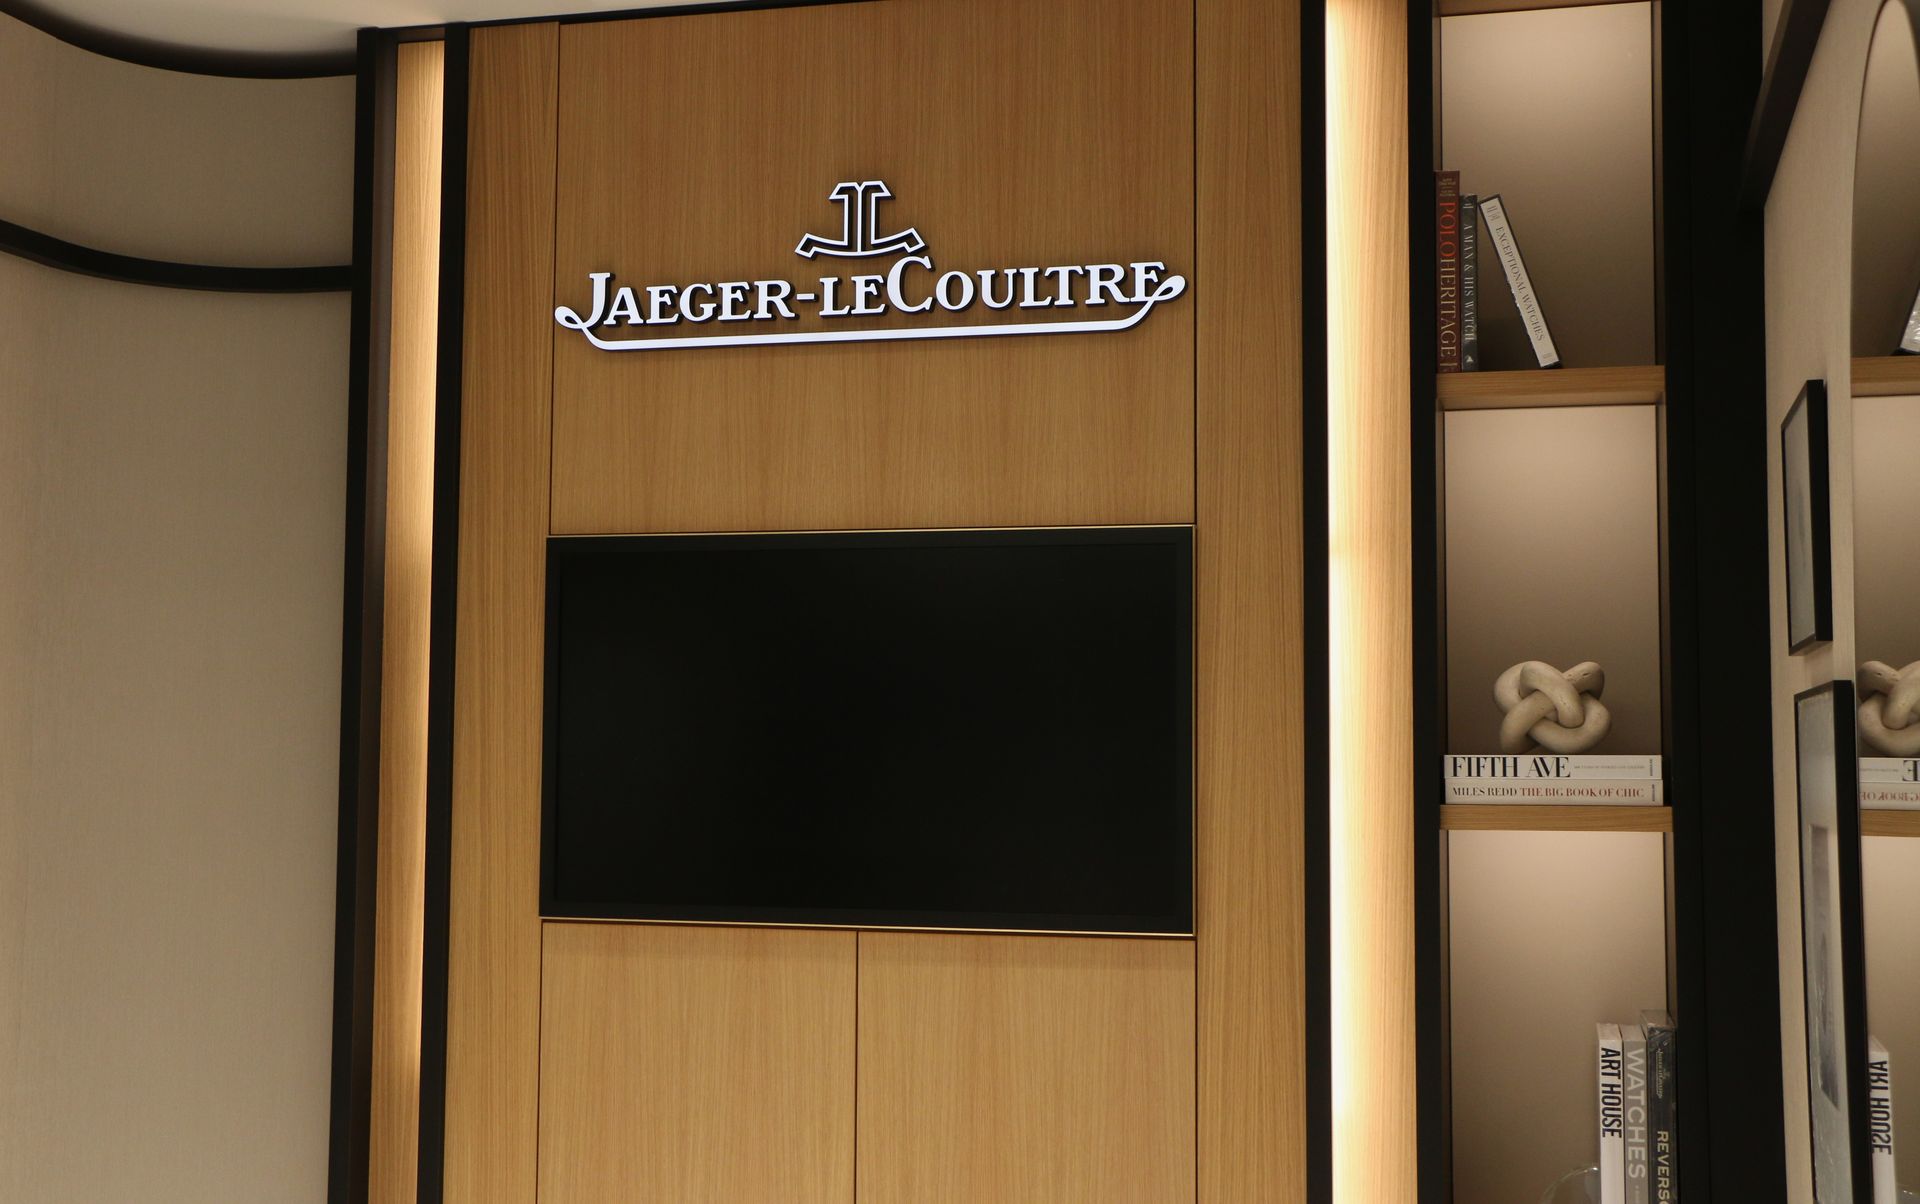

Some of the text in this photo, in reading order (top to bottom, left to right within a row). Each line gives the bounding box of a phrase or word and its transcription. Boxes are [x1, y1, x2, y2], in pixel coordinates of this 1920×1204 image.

[1463, 234, 1474, 259] MAN
[1463, 264, 1474, 272] &
[1495, 226, 1545, 341] EXCEPTIONAL WATCHES
[1463, 277, 1474, 296] HIS
[1463, 301, 1475, 341] WATCH
[1451, 756, 1571, 778] FIFTH AVE
[1452, 787, 1485, 797] MILES
[1487, 787, 1517, 797] REDD
[1520, 787, 1541, 798] THE
[1544, 788, 1564, 798] BIG
[1566, 788, 1597, 798] BOOK
[1598, 788, 1613, 798] OF
[1615, 788, 1644, 798] CHIC
[1600, 1047, 1622, 1138] ART HOUSE
[1626, 1047, 1646, 1179] WATCHES
[1656, 1130, 1671, 1204] REVERS
